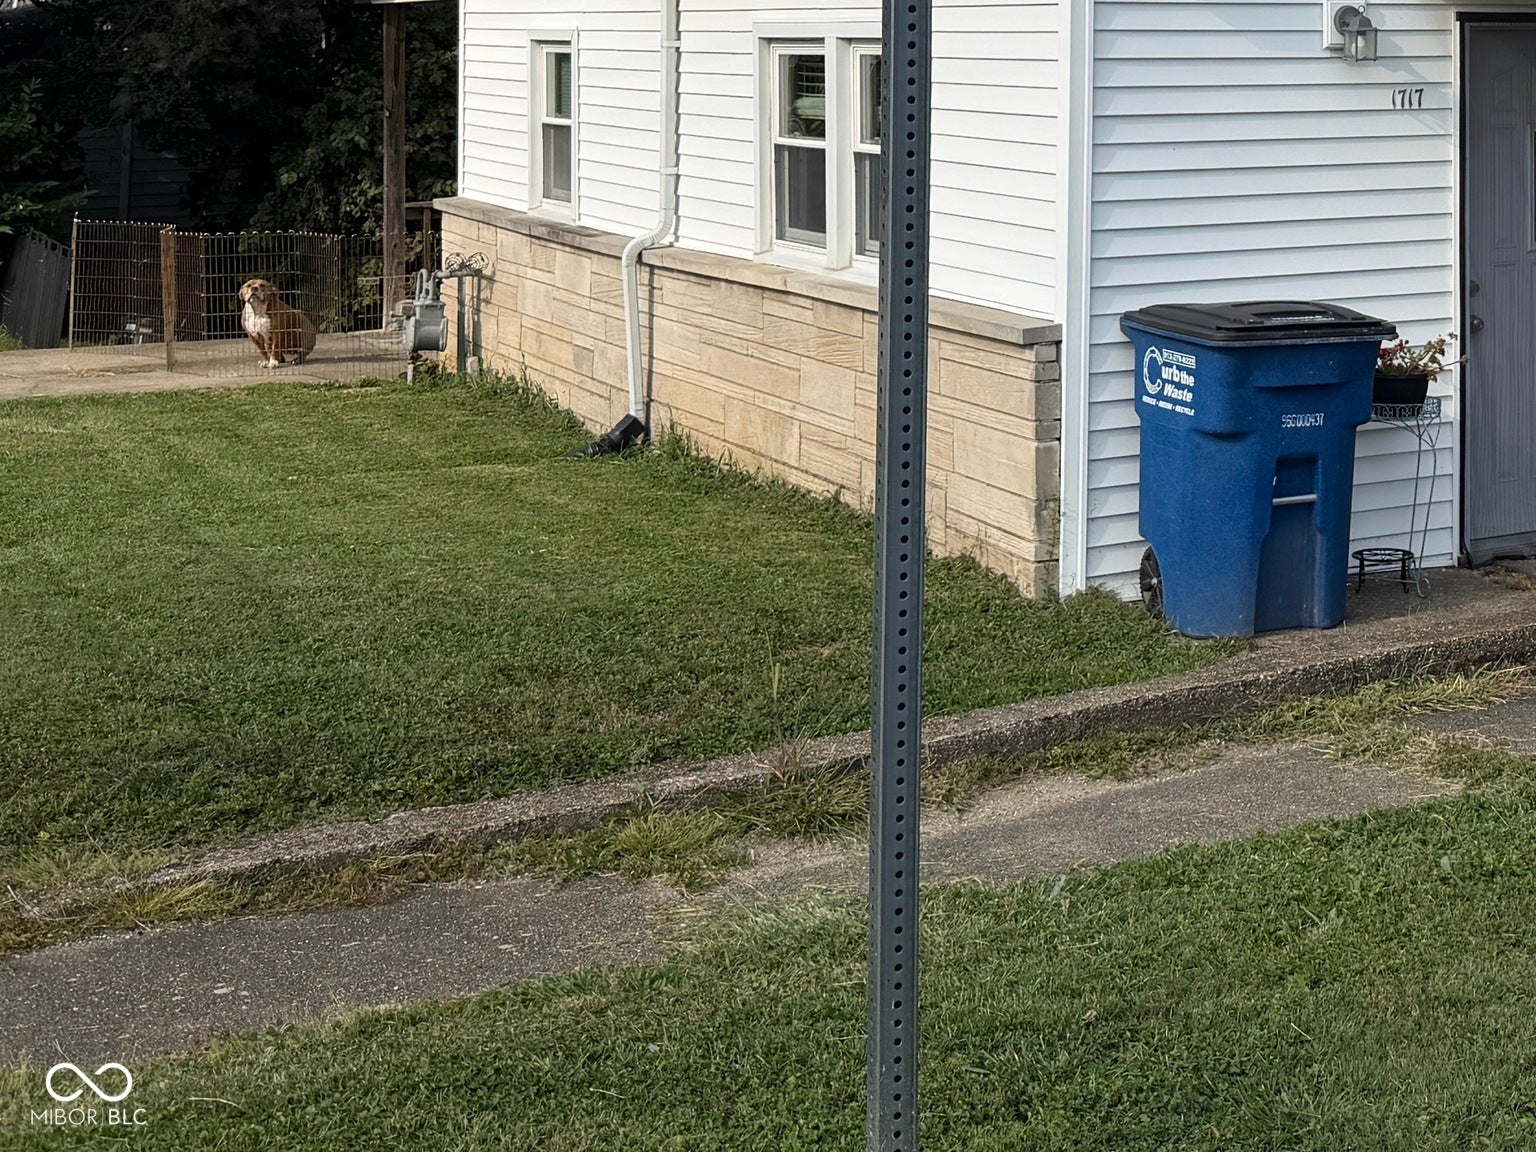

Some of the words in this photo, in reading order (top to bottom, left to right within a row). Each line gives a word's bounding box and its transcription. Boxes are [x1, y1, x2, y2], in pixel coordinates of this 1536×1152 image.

[1392, 88, 1424, 109] 1717
[1143, 346, 1180, 394] Curb
[1180, 370, 1195, 387] the
[1163, 382, 1193, 403] Waste
